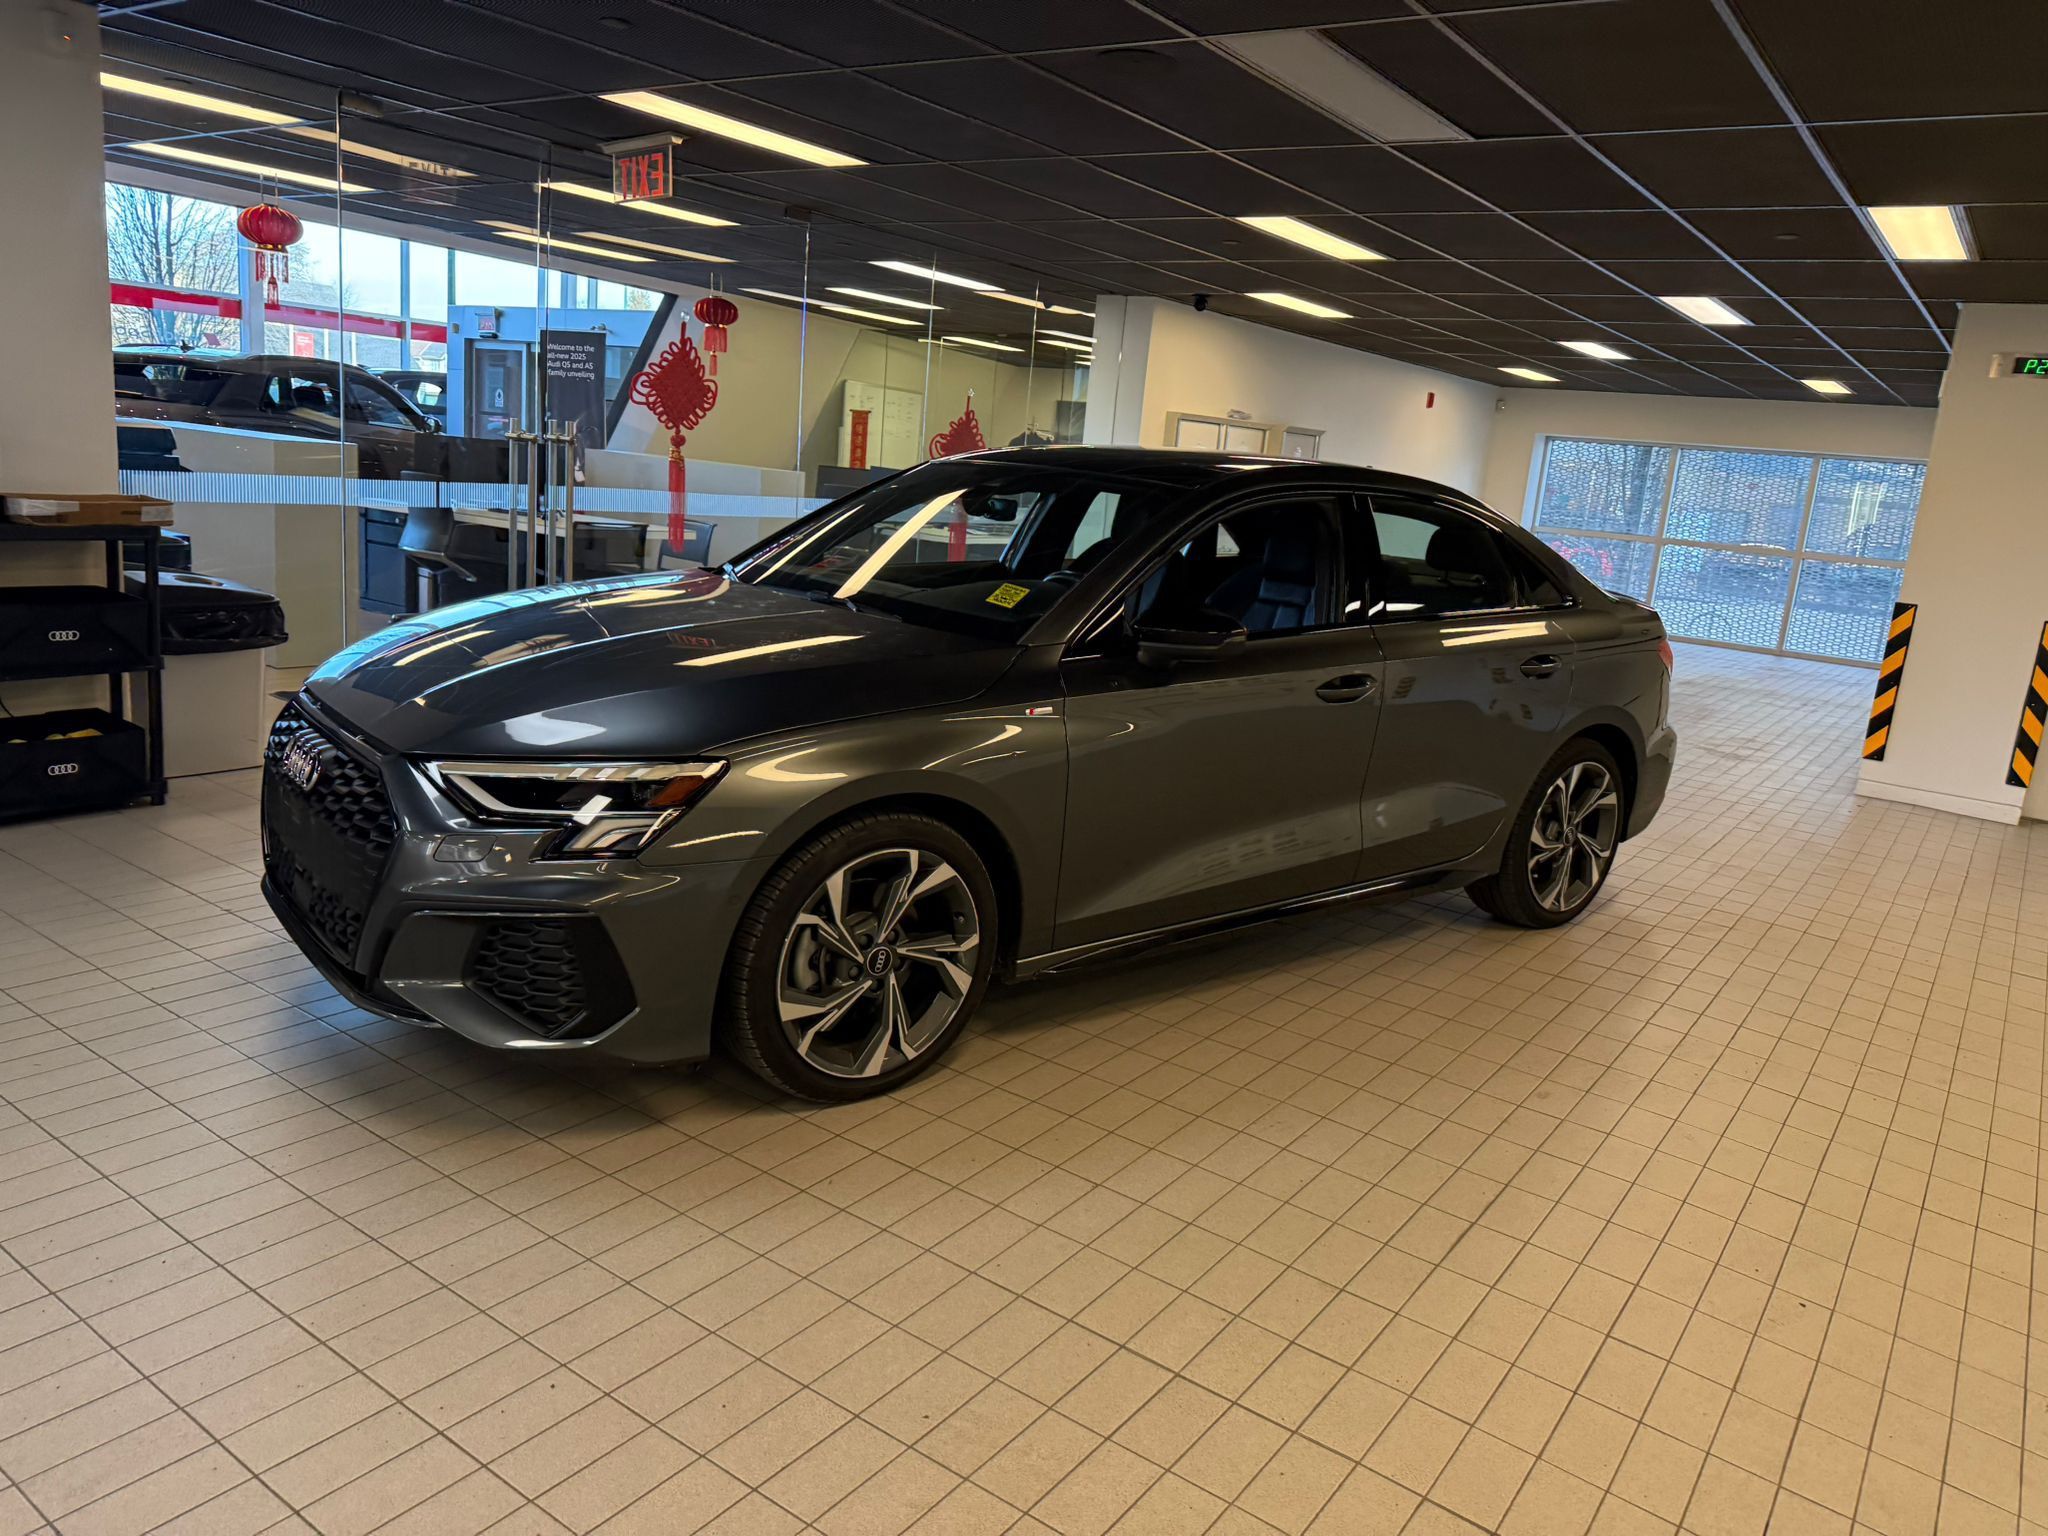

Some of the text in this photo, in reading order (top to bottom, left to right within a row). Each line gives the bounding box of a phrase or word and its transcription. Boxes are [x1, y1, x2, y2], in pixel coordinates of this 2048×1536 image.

[570, 352, 587, 360] 2025
[547, 360, 560, 368] Audi
[547, 369, 595, 380] family unveiling
